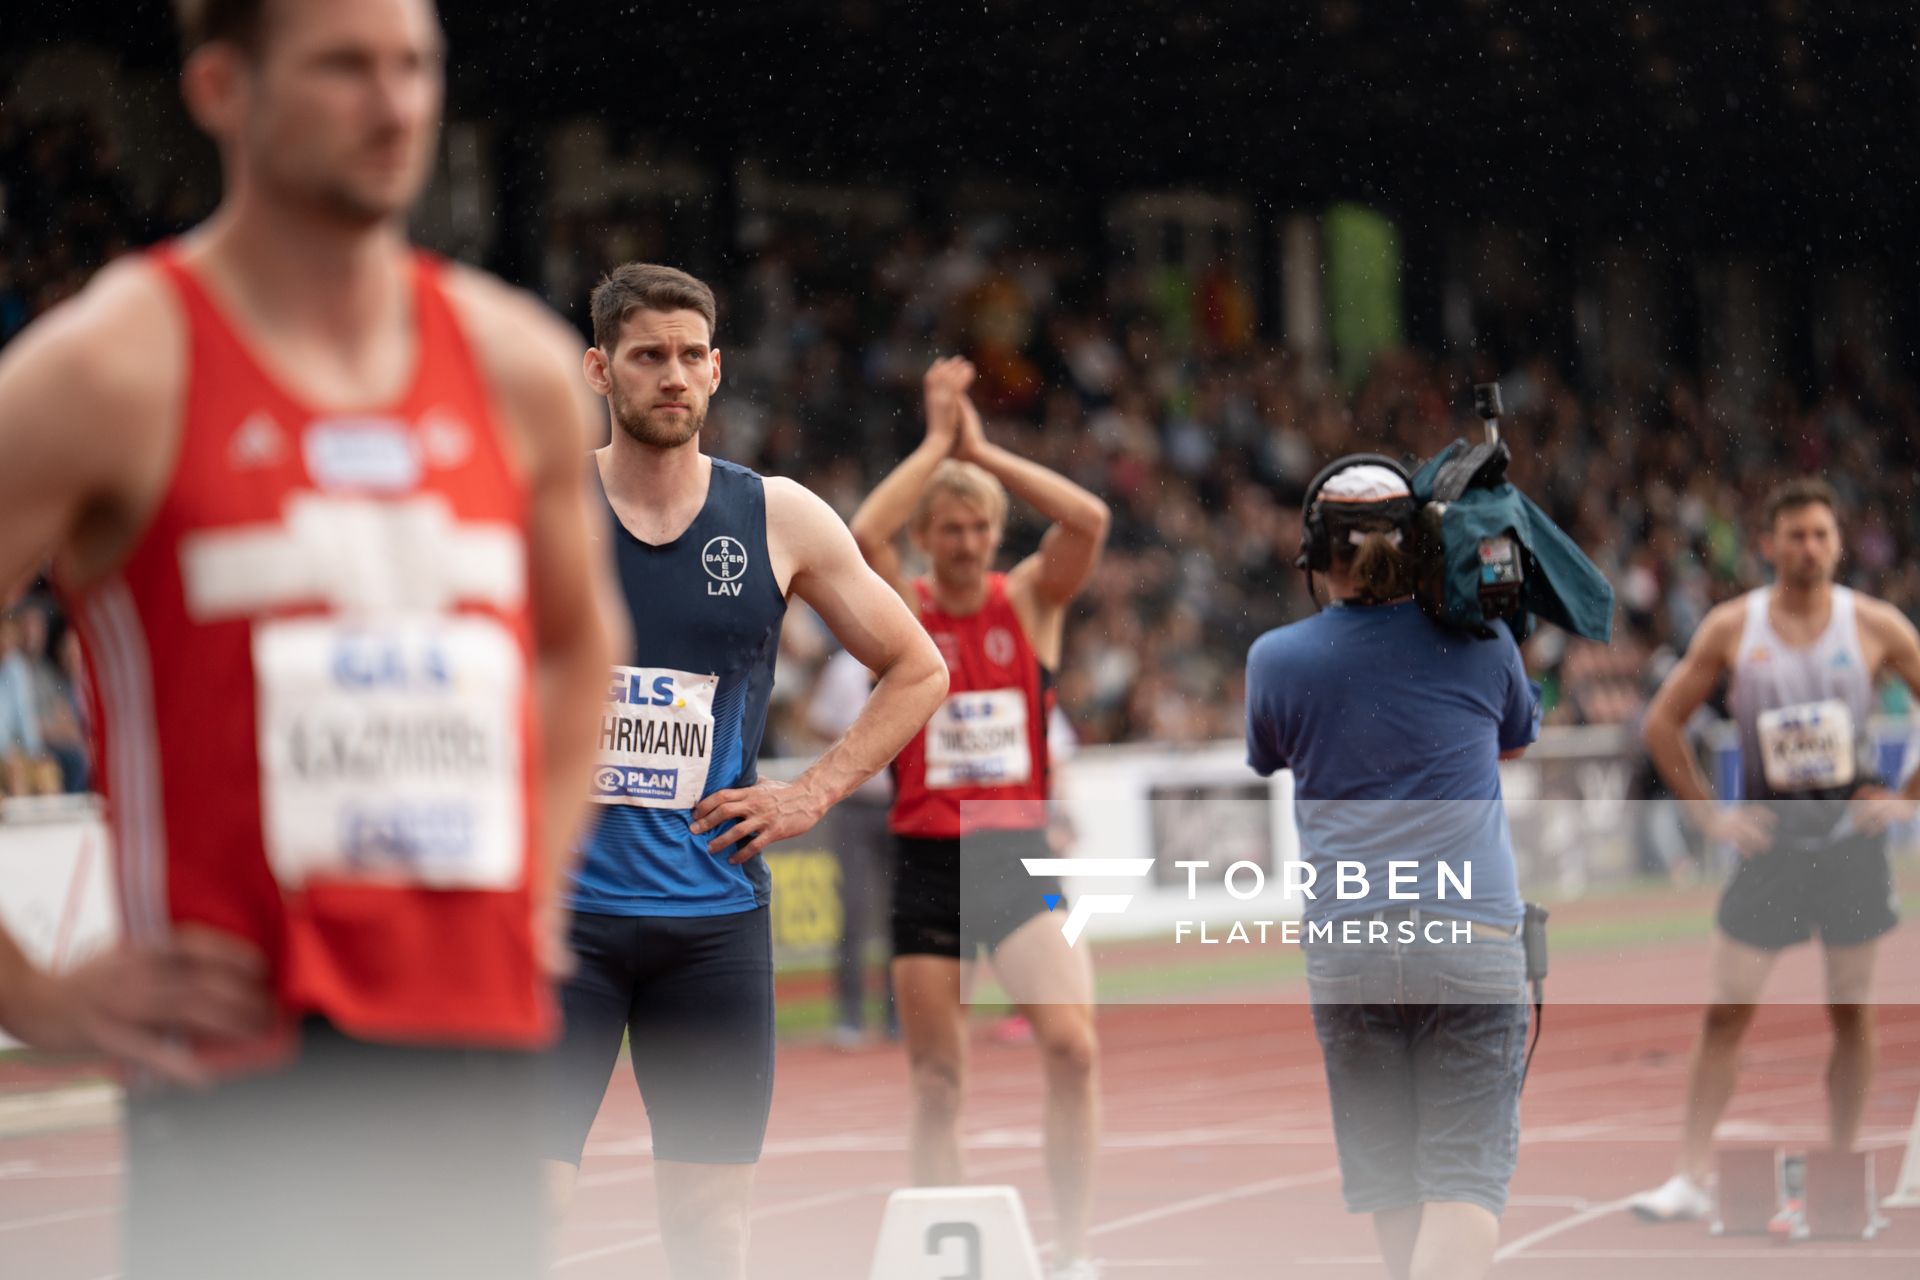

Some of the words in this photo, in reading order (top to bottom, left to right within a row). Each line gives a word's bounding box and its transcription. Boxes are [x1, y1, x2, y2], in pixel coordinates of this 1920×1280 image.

[706, 554, 744, 564] BAYER
[721, 540, 729, 577] BAYER
[707, 581, 743, 597] LAV
[627, 771, 675, 790] PLAN
[626, 787, 673, 797] INTERNATIONAL
